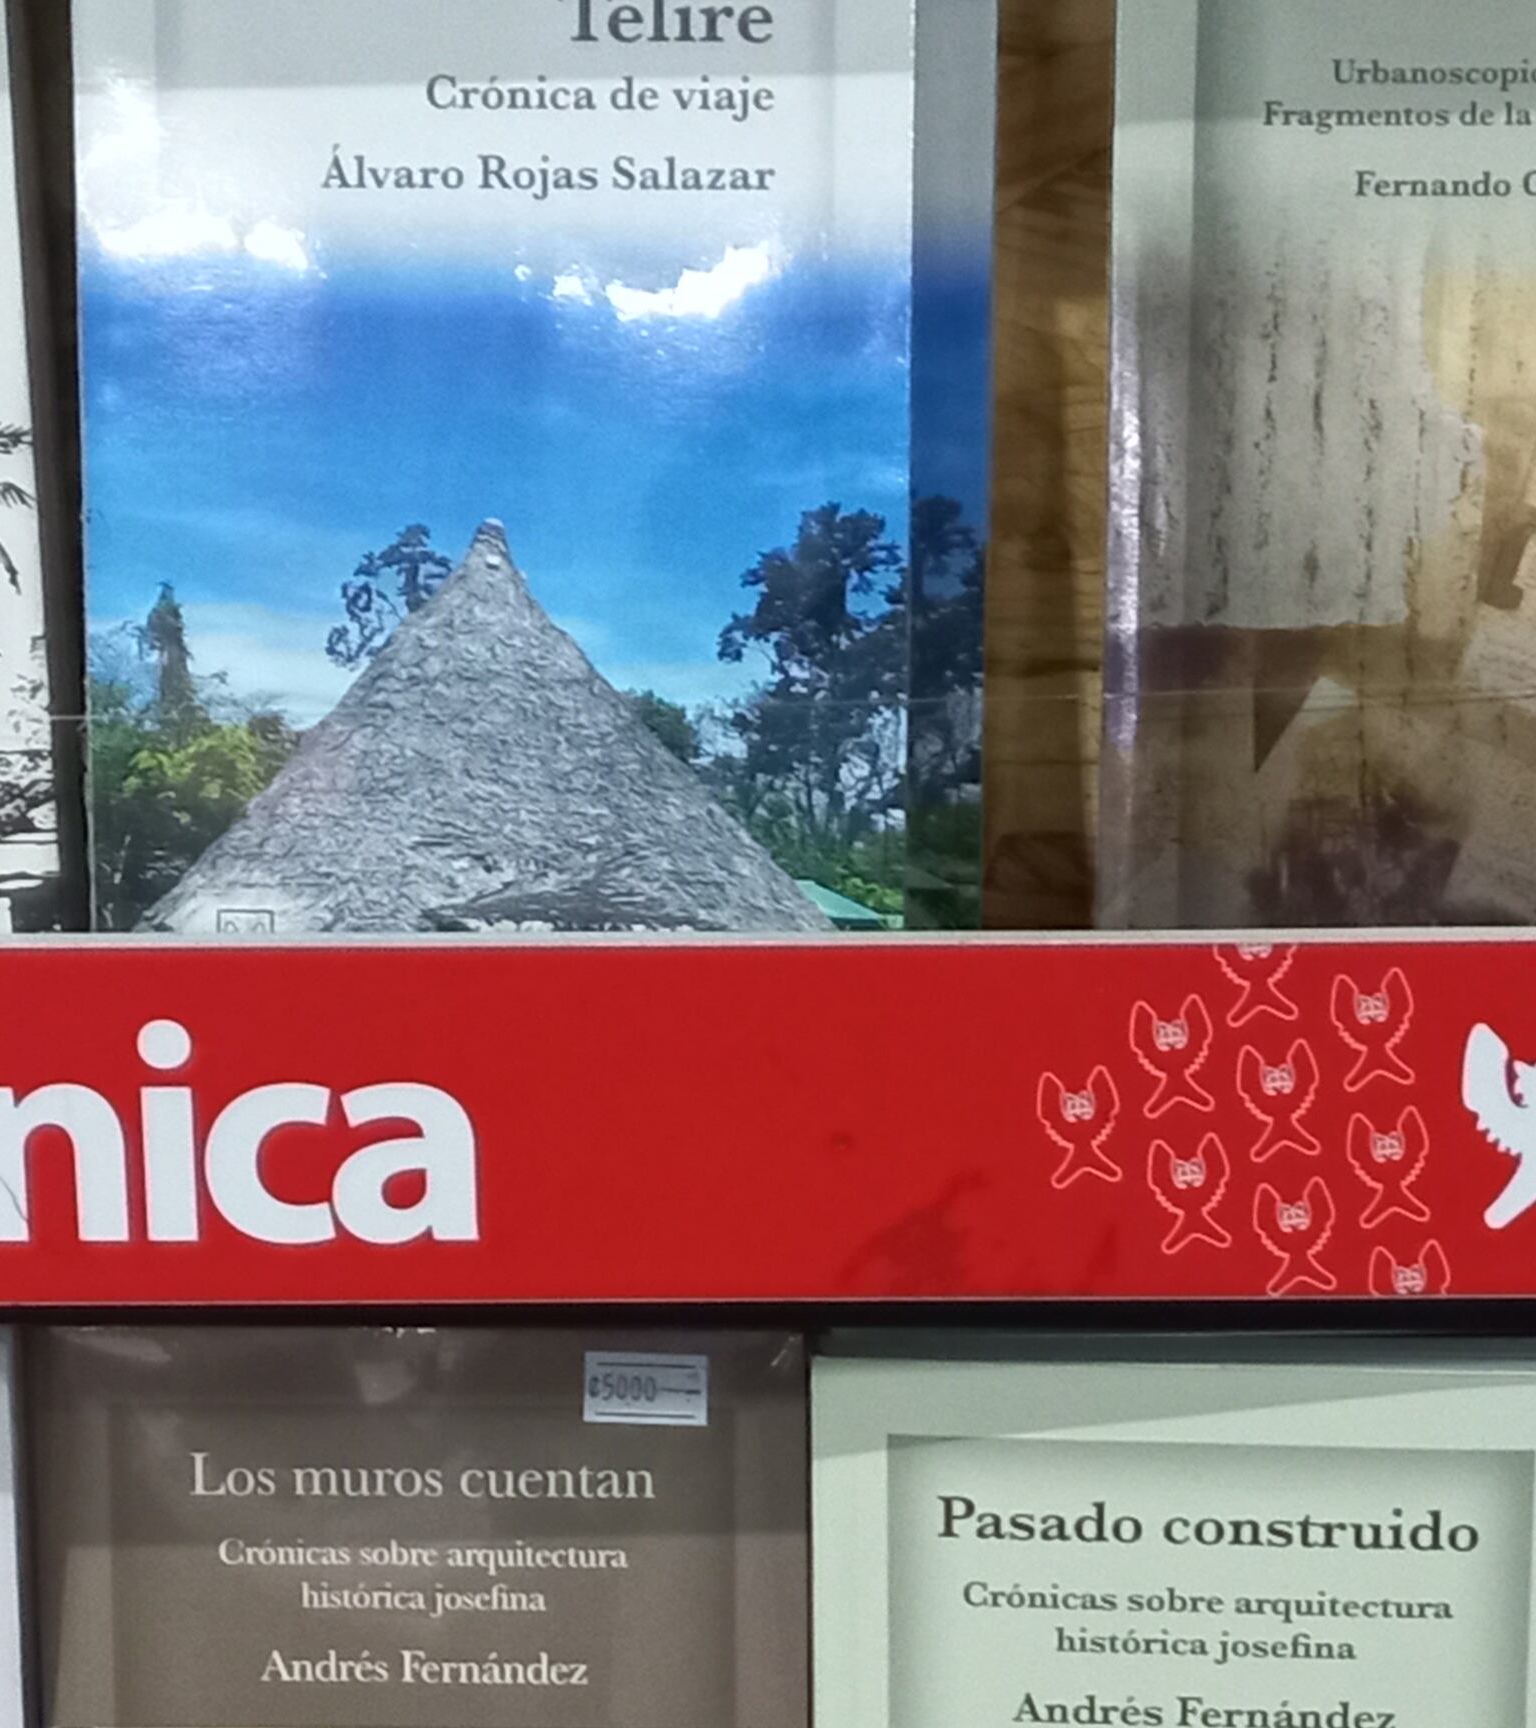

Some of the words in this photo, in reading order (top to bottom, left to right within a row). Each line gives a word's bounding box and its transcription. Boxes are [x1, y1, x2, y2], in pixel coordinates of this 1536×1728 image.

[426, 74, 597, 111] Crónica
[610, 76, 659, 111] de
[673, 75, 774, 123] viaje
[1263, 100, 1450, 135] Fragmentos
[1459, 100, 1494, 127] de
[1504, 101, 1532, 126] la
[321, 143, 464, 190] Álvaro
[478, 154, 599, 201] Rojas
[612, 155, 776, 191] Salazar
[1355, 170, 1512, 198] Fernando
[190, 1452, 276, 1497] Los
[293, 1467, 443, 1497] muros
[460, 1466, 656, 1499] cuentan
[938, 1496, 1143, 1544] Pasado
[1163, 1508, 1479, 1552] construido
[218, 1539, 351, 1566] Crónicas
[359, 1539, 439, 1567] sobre
[447, 1540, 629, 1576] arquitectura
[301, 1581, 426, 1610] histórica
[429, 1583, 547, 1618] josefina
[963, 1581, 1118, 1612] Crónicas
[1127, 1587, 1224, 1614] sobre
[1234, 1590, 1454, 1624] arquitectura
[1055, 1626, 1209, 1656] histórica
[1214, 1630, 1357, 1665] josefina
[261, 1649, 389, 1682] Andrés
[401, 1650, 588, 1685] Fernández
[1012, 1692, 1163, 1727] Andrés
